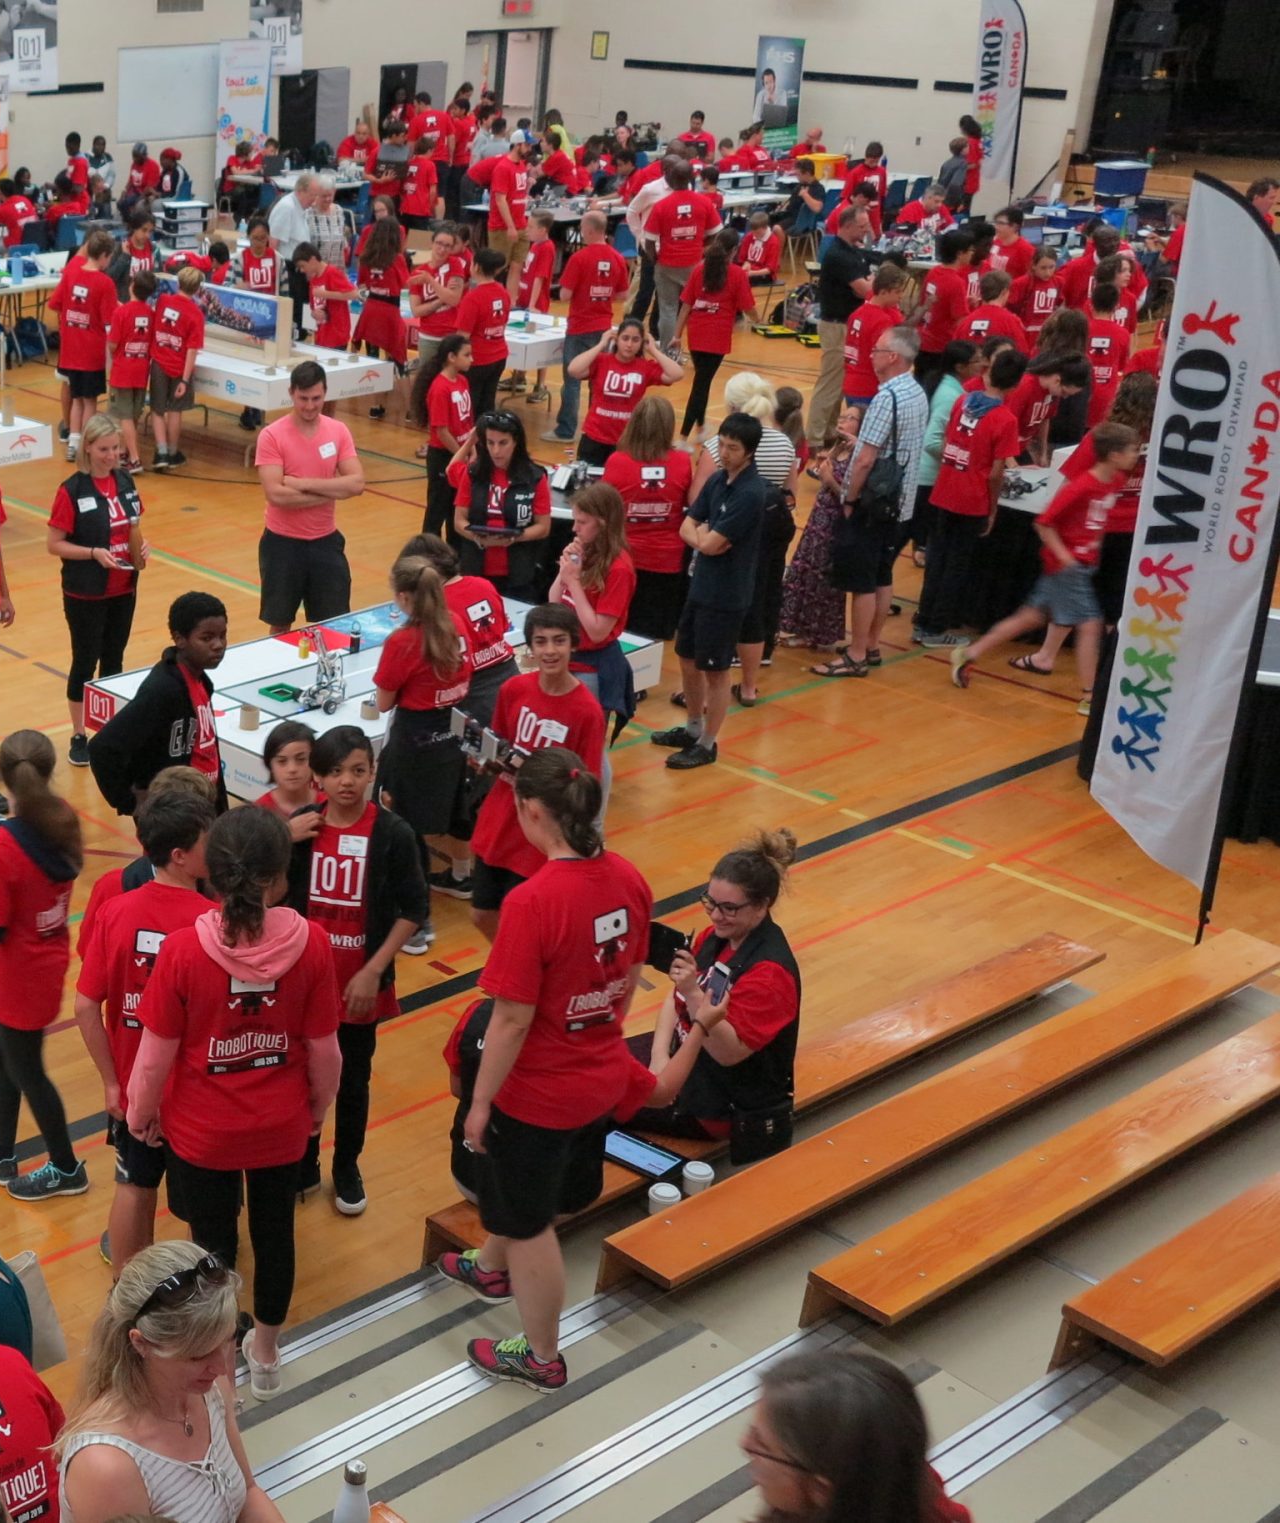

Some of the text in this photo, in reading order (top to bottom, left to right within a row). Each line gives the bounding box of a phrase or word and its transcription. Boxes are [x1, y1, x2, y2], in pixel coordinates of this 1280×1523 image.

[980, 30, 1003, 91] WRO
[1144, 348, 1231, 545] WRO
[1201, 359, 1249, 554] WORLD ROBOT OLYMPIAD
[310, 851, 366, 900] [01]
